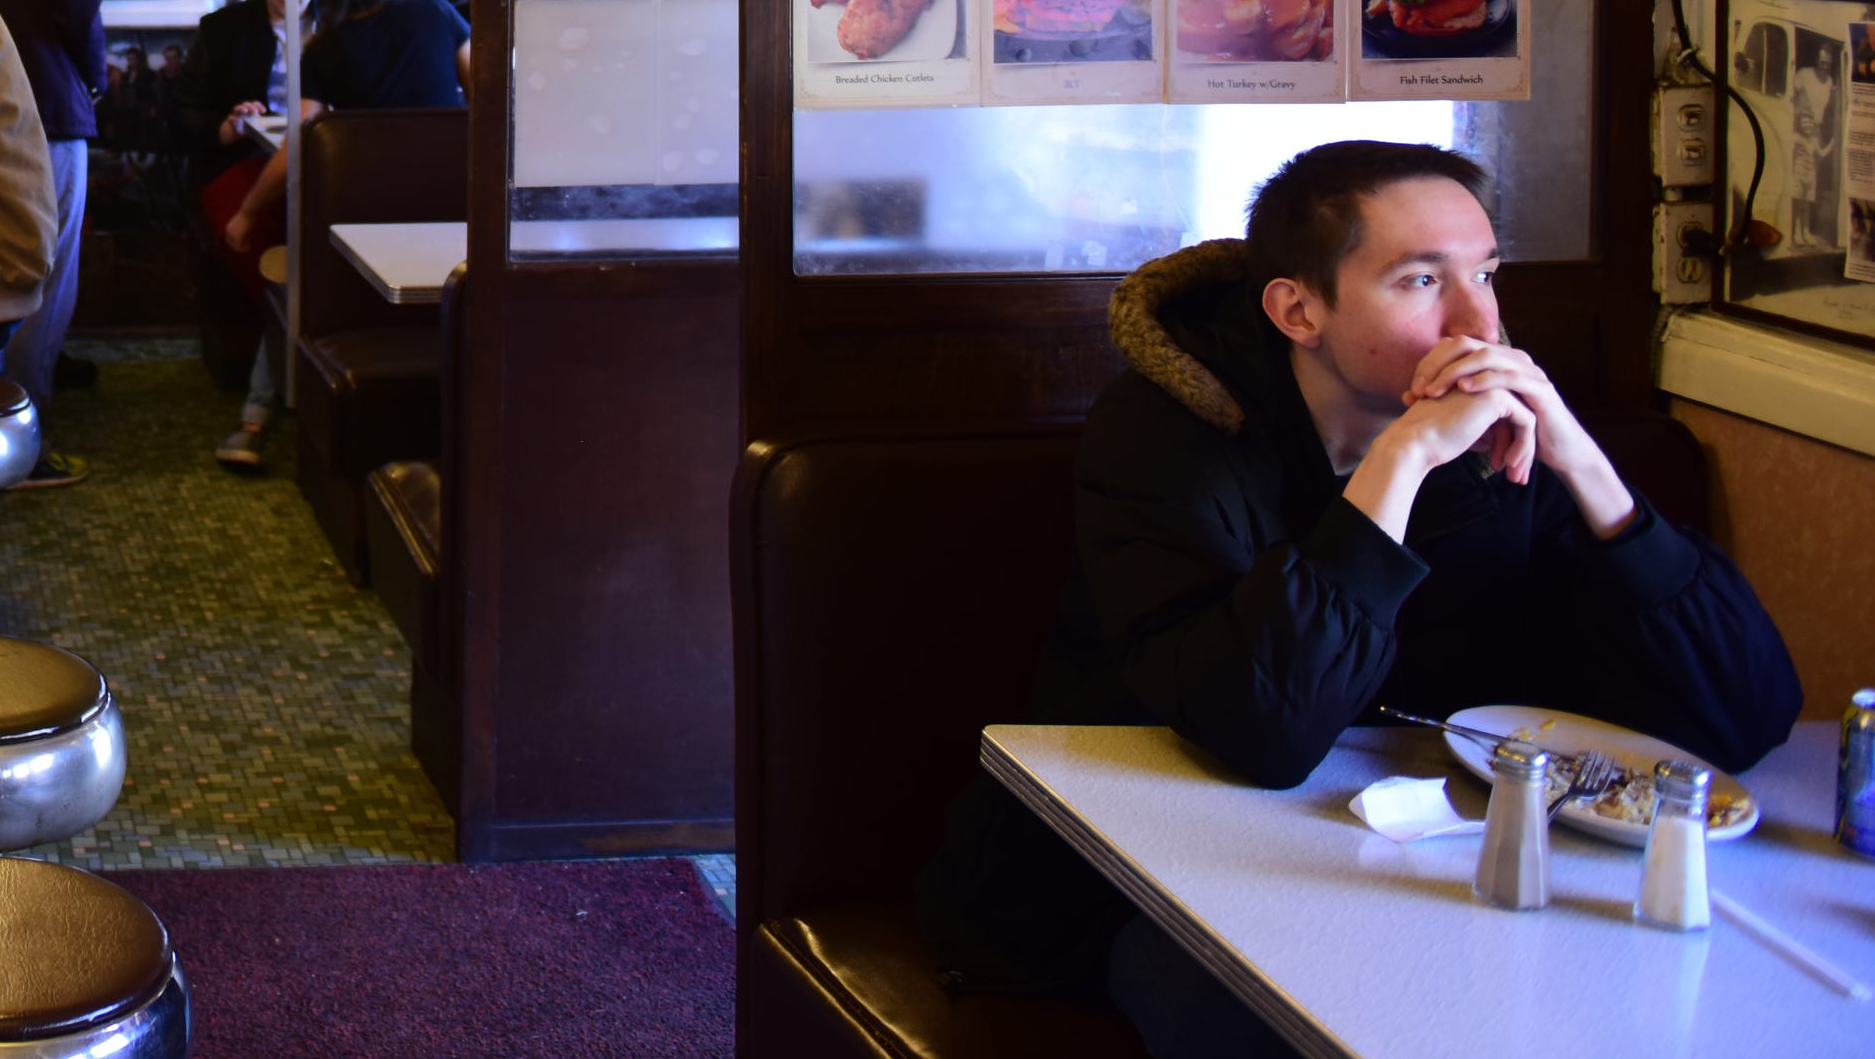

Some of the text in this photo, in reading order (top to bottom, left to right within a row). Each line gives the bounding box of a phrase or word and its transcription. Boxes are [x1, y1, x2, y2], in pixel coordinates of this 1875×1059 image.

[835, 73, 935, 85] Breaded Chicken Cutlets
[1207, 79, 1296, 91] Hot Turkey w/Gravy
[1399, 74, 1484, 86] Fish Filet Sandwich
